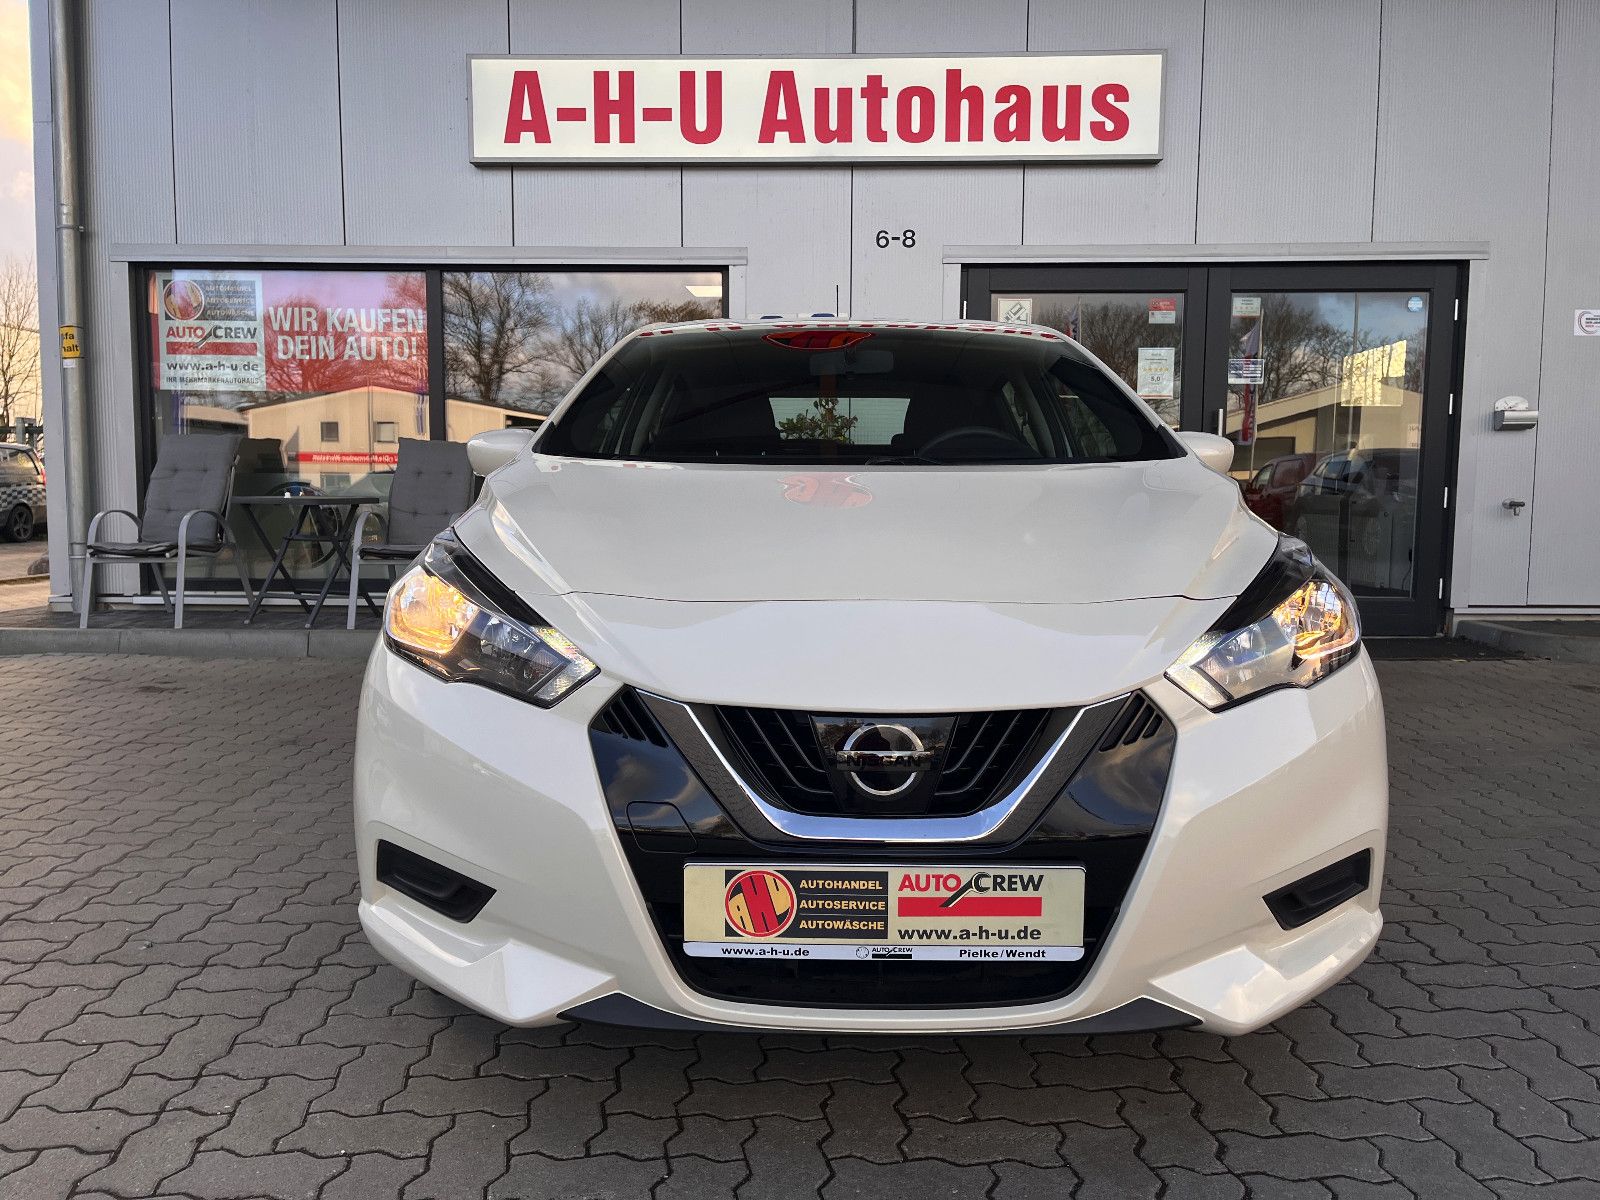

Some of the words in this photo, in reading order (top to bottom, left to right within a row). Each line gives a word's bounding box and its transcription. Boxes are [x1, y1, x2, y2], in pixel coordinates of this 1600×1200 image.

[503, 70, 723, 144] A-H-U
[757, 69, 1130, 144] Autohaus
[876, 229, 916, 248] 6-8
[268, 306, 318, 332] WIR
[326, 307, 424, 333] KAUFEN
[277, 335, 335, 360] DEIN
[342, 336, 417, 362] AUTO!
[167, 361, 259, 371] www.a-h-u.de
[799, 879, 883, 890] AUTOHANDEL
[799, 900, 886, 910] AUTOSERVICE
[799, 919, 885, 930] AUTOWÄSCHE
[898, 926, 1042, 940] www.a-h-u.de
[721, 947, 810, 957] www.a-h-u.de
